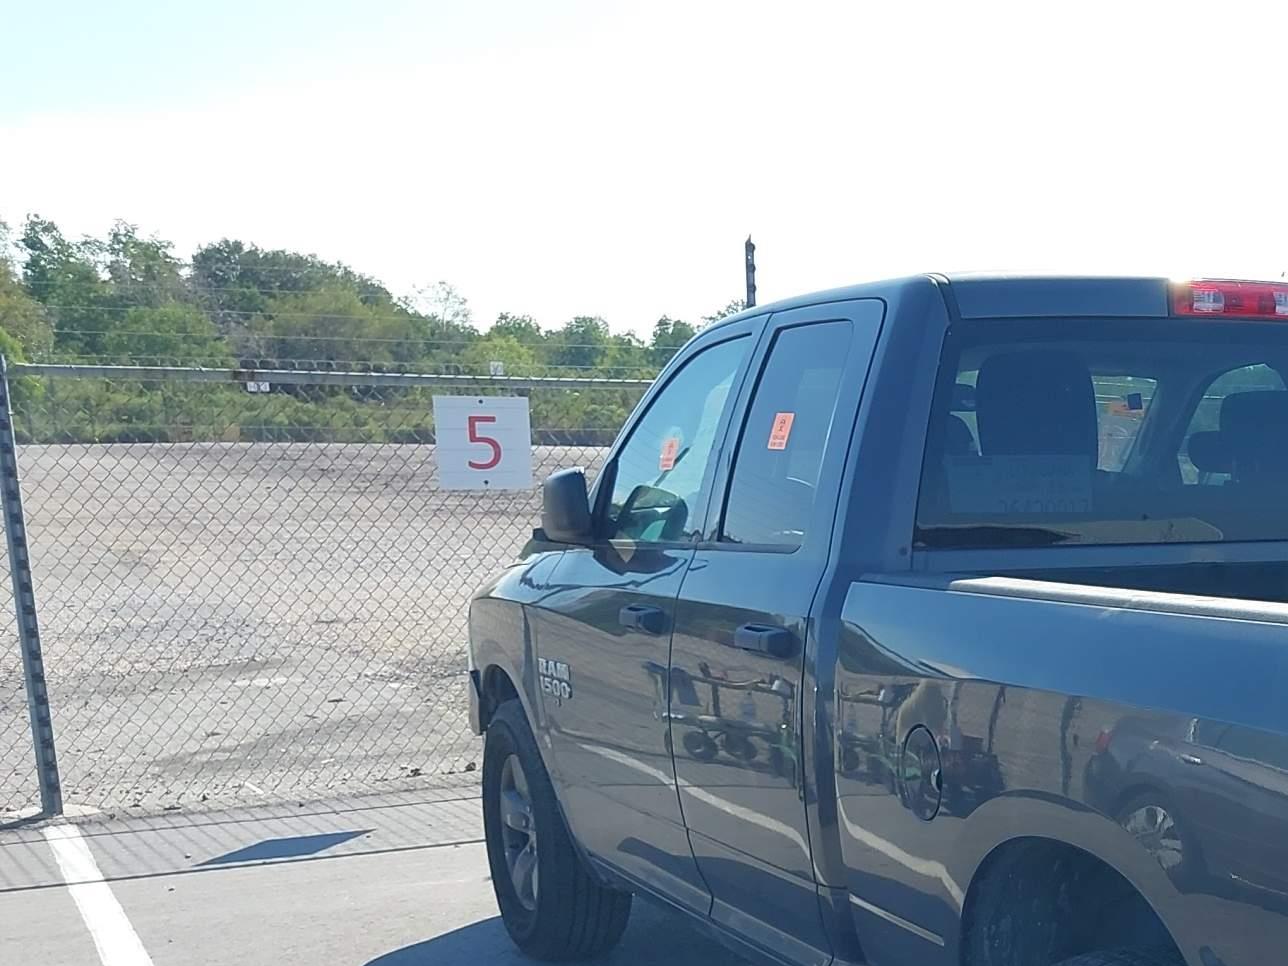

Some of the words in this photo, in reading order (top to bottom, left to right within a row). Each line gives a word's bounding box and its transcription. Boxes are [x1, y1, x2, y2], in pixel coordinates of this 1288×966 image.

[467, 415, 502, 470] 5
[537, 657, 570, 681] RAM
[539, 675, 571, 699] 1500
